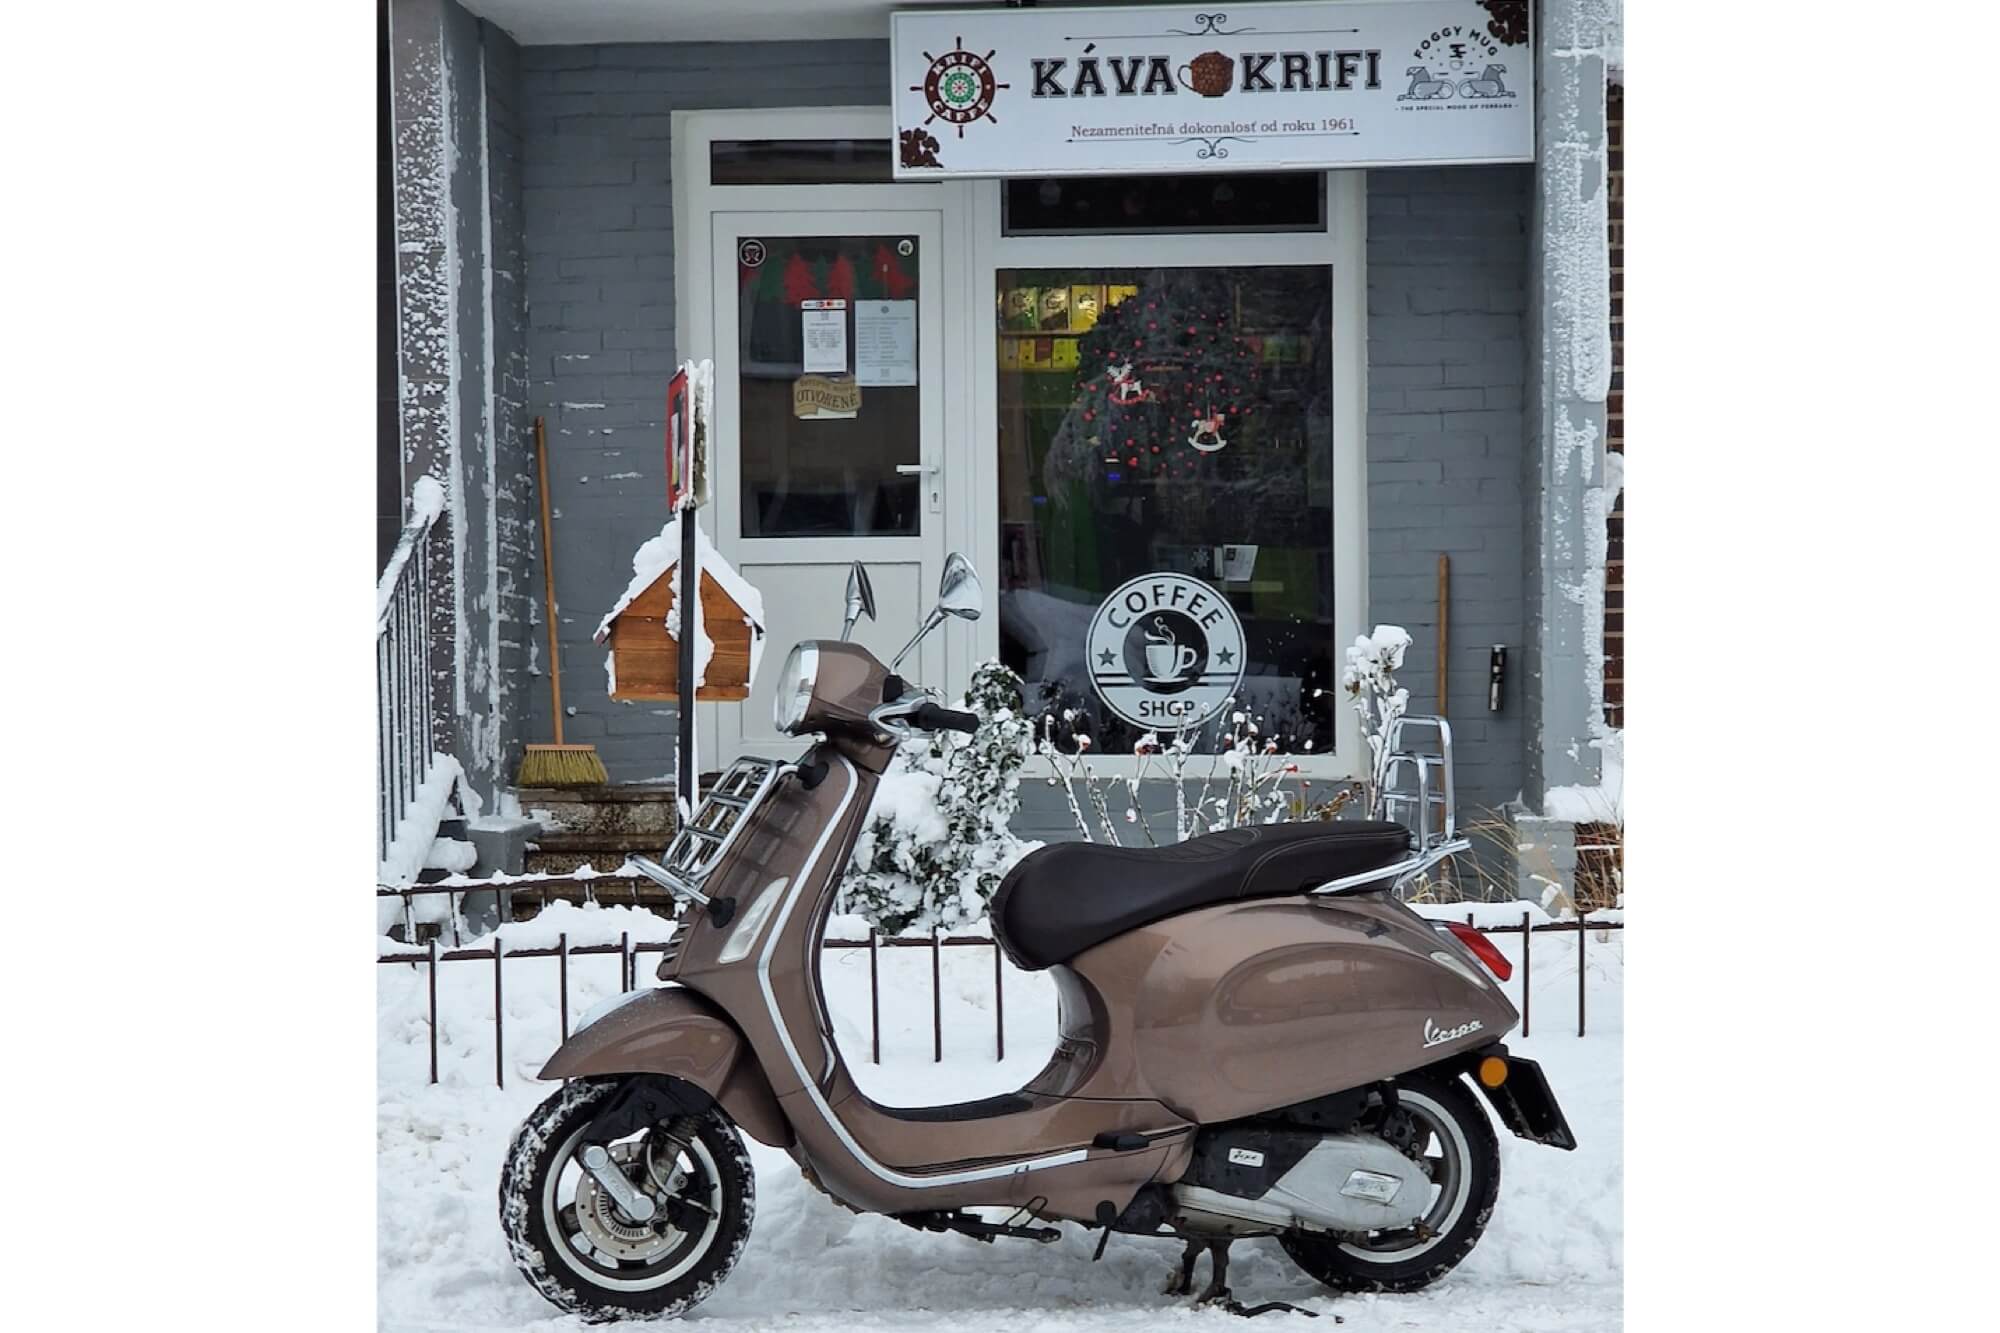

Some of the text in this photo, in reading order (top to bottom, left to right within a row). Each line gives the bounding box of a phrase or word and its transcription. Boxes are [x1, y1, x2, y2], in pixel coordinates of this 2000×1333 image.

[1414, 25, 1498, 60] FOGGY MUG
[933, 54, 987, 75] KRIFI
[1030, 42, 1382, 98] KÁVA KRIFI
[1071, 118, 1355, 137] Nezameniteľná dokonalosť od roku 1961
[1108, 584, 1224, 630] COFFEE
[1423, 1017, 1484, 1049] Vespa
